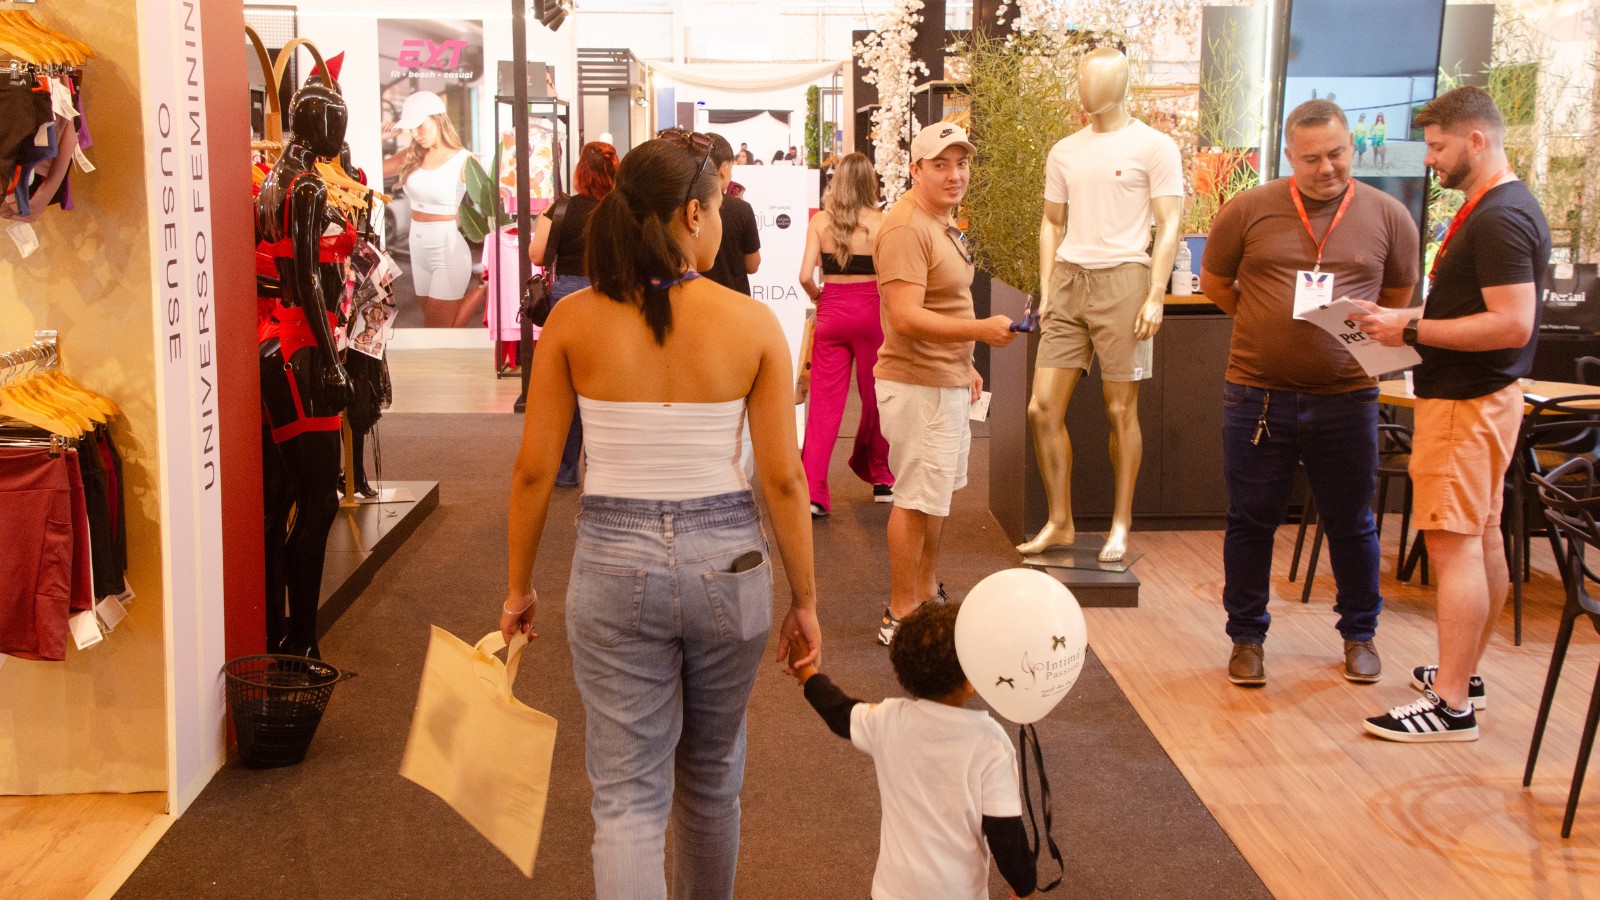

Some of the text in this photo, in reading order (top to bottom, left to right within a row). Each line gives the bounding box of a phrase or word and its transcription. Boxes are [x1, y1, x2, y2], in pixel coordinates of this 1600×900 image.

[398, 39, 468, 69] EXT
[390, 70, 474, 79] fit beach casual
[158, 102, 182, 363] OUSEUSE
[183, 1, 215, 491] UNIVERSO FEMININ
[752, 285, 799, 300] RIDA
